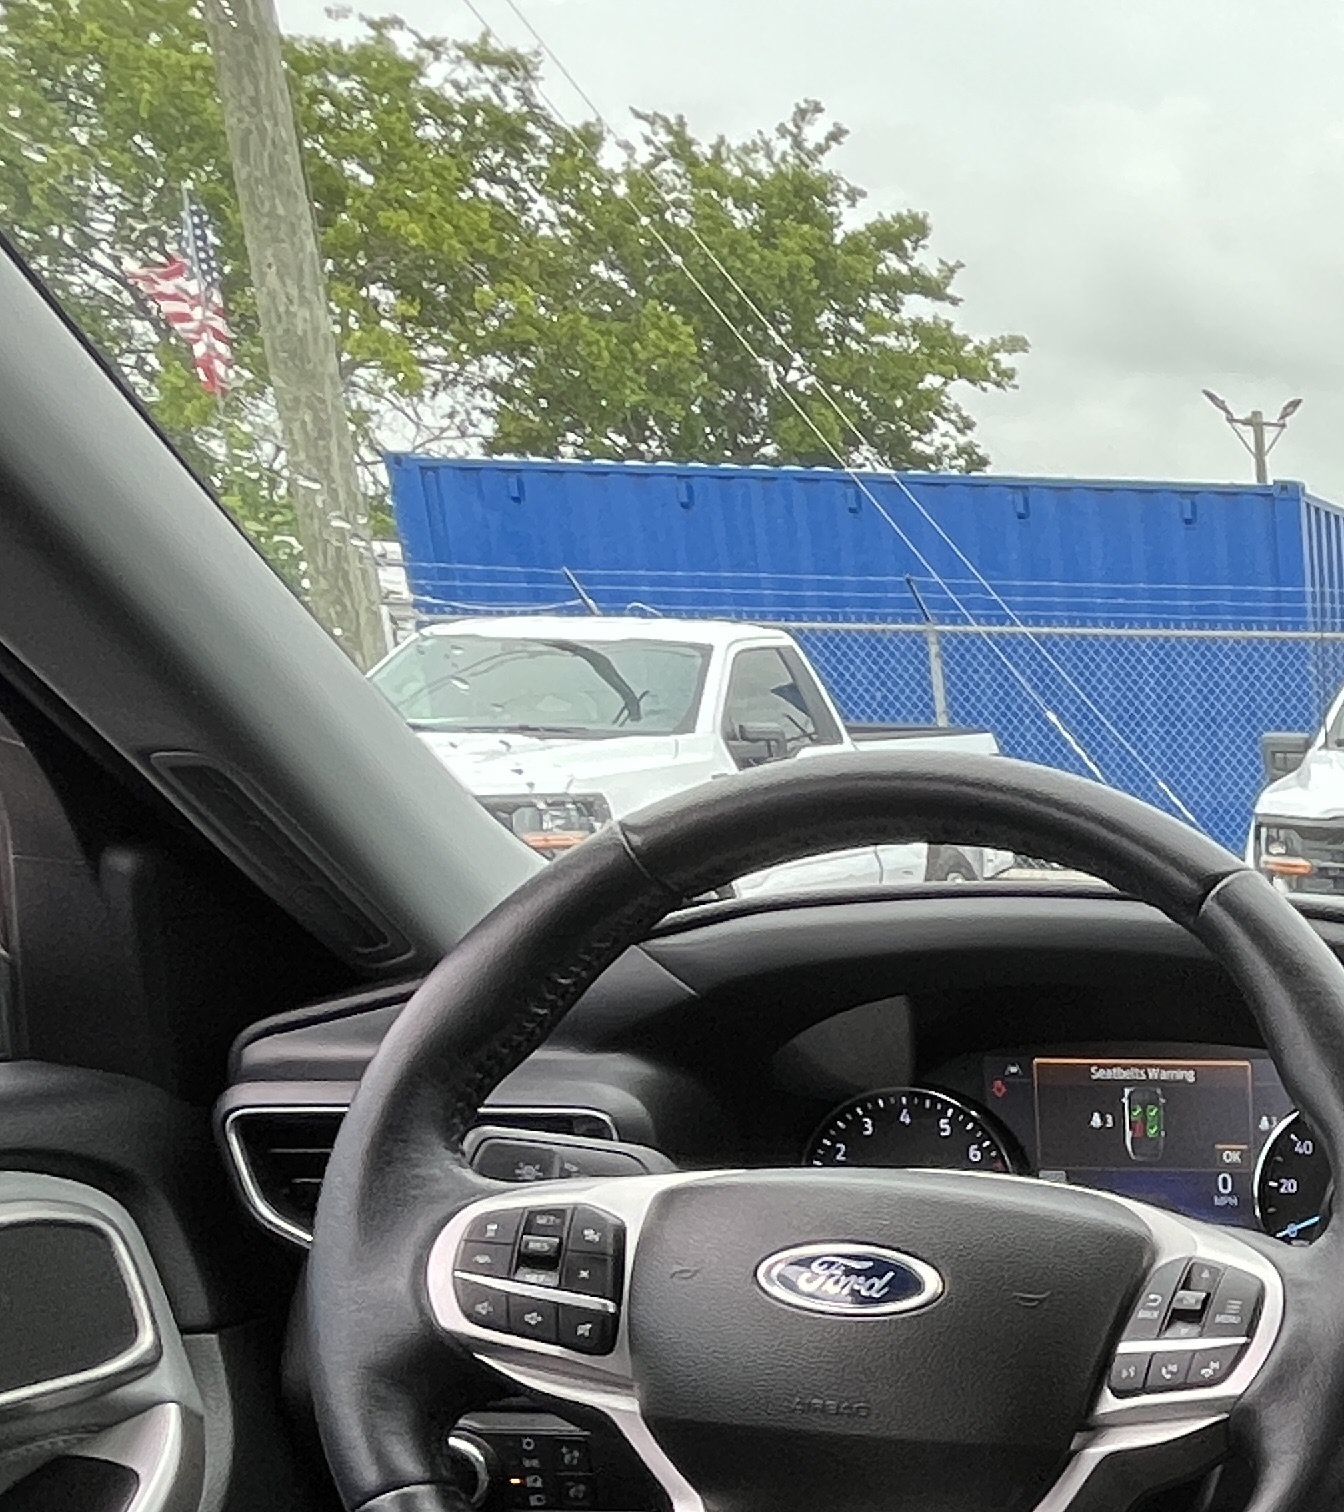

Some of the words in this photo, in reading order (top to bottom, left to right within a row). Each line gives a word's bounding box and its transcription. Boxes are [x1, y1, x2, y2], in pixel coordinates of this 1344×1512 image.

[1090, 1066, 1146, 1080] Seatbelts
[1147, 1067, 1195, 1083] Warning
[899, 1108, 911, 1125] 4
[862, 1117, 873, 1136] 3
[938, 1118, 951, 1136] 5
[835, 1143, 846, 1161] 2
[968, 1144, 982, 1162] 6
[1222, 1150, 1242, 1163] OK
[1294, 1140, 1314, 1156] 40
[1217, 1173, 1233, 1195] 0
[1279, 1179, 1298, 1195] 20
[797, 1256, 896, 1298] Ford
